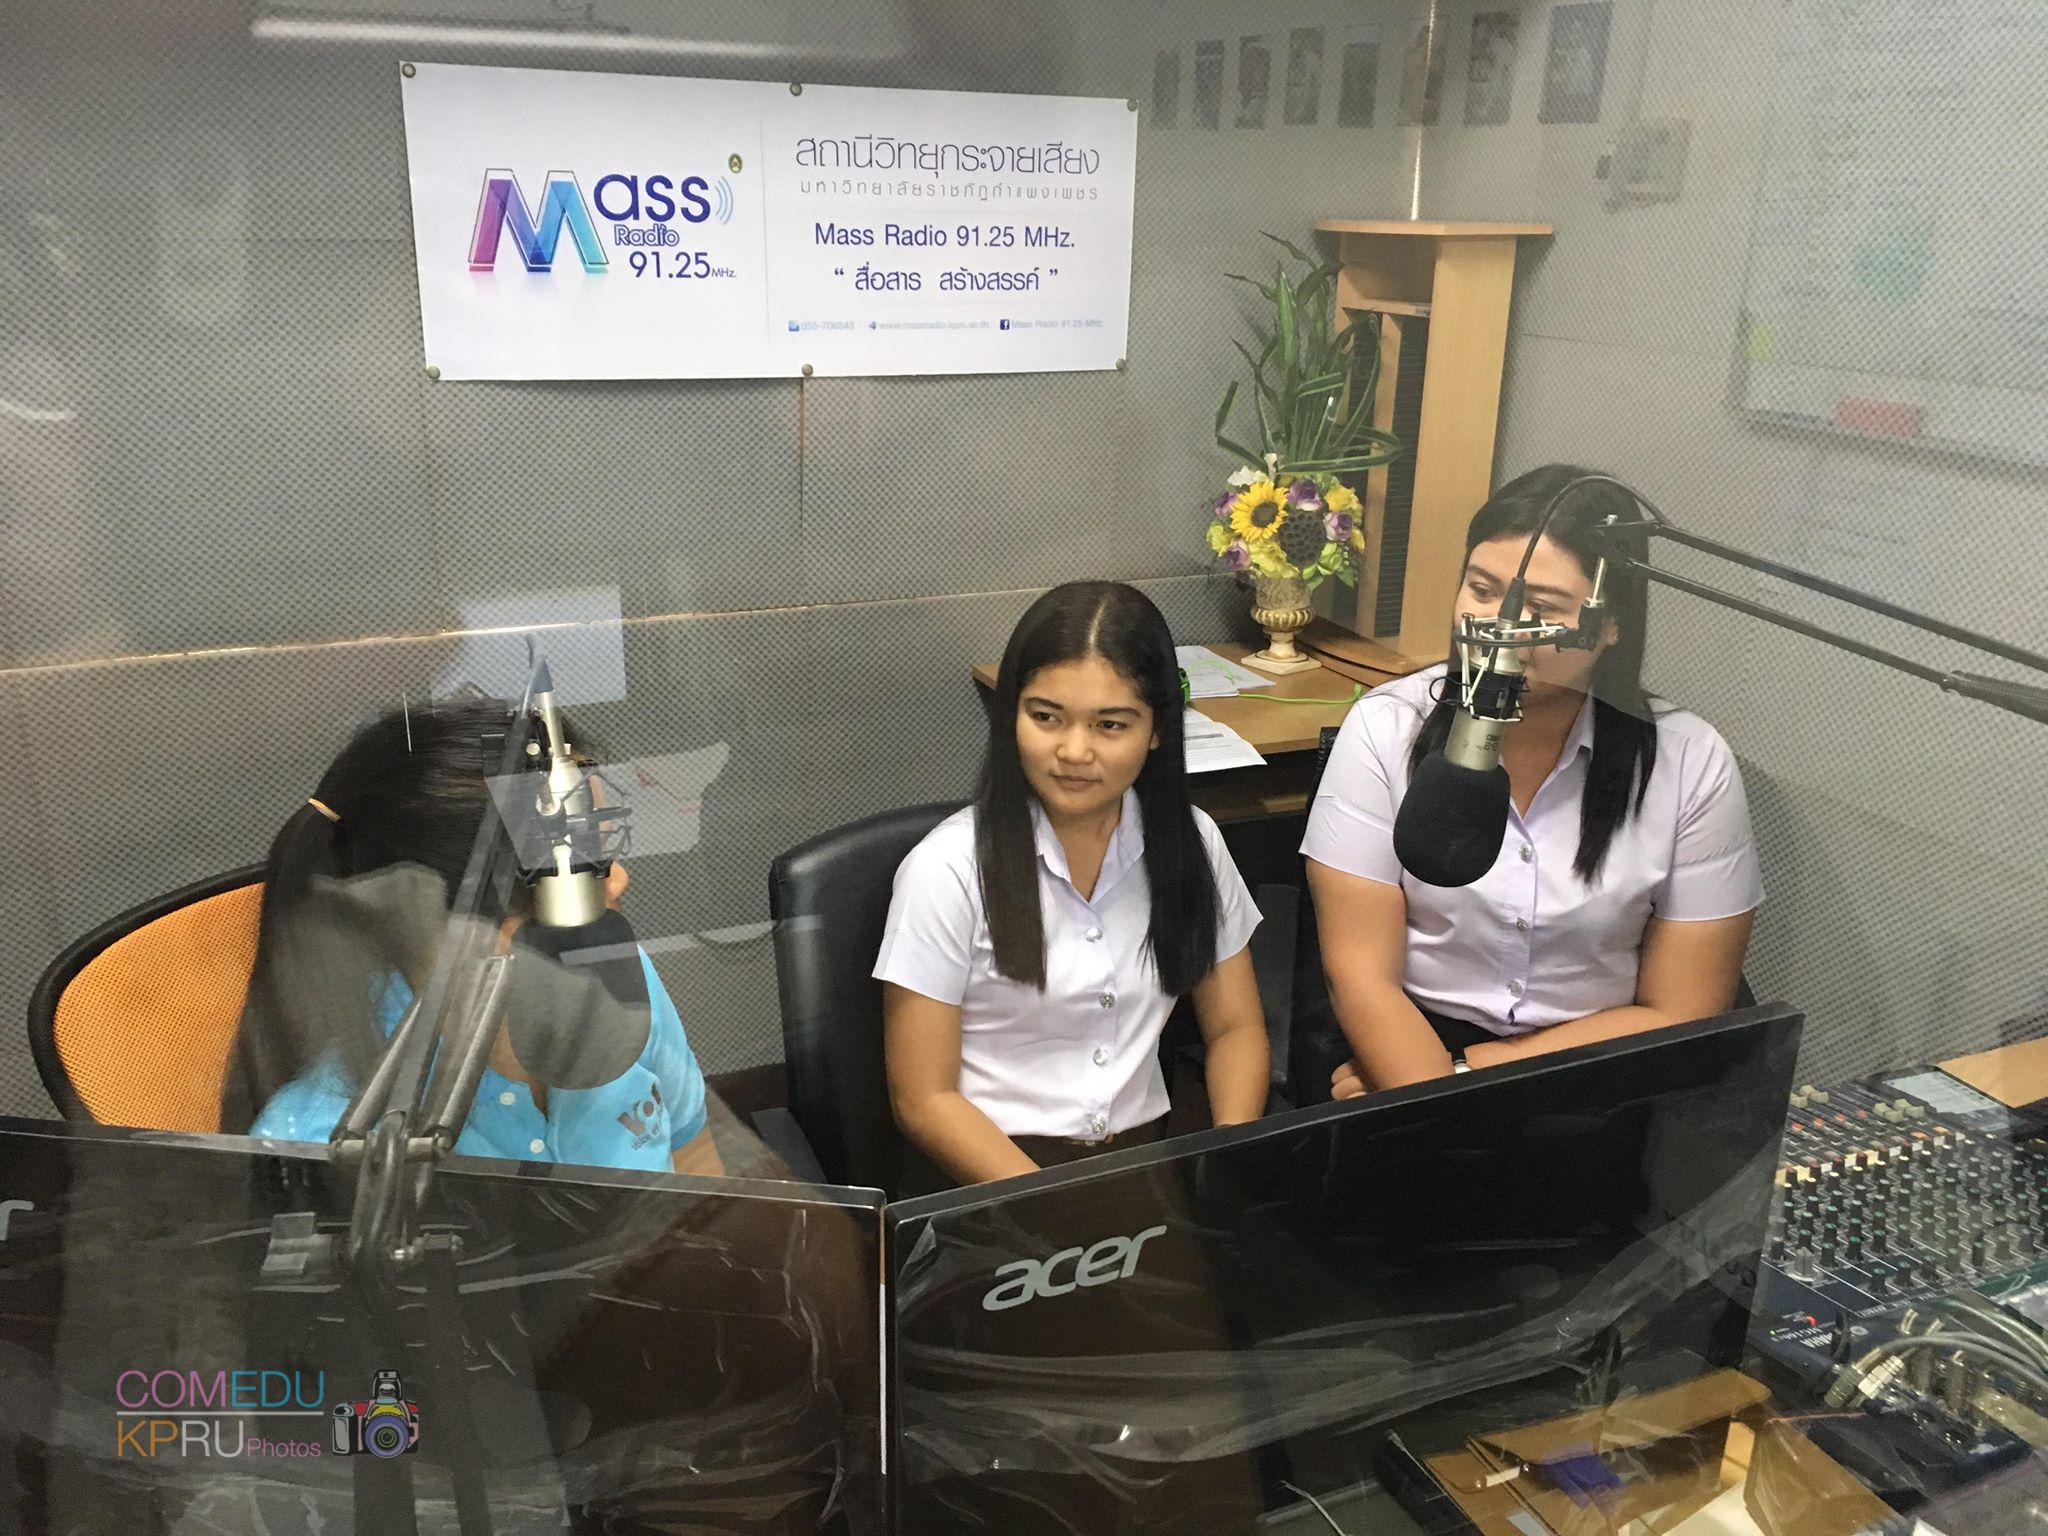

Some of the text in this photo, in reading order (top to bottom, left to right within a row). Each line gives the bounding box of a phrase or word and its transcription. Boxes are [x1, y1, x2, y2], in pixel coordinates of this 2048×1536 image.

[796, 134, 1100, 178] สถานีวิทยุกระจายเสียง
[467, 168, 711, 273] Mass
[614, 223, 680, 247] Radio
[815, 223, 1075, 247] Mass Radio 91.25 MHz.
[629, 251, 711, 278] 91.25
[855, 261, 922, 291] สื่อสาร
[939, 267, 1040, 291] สร้างสรรค์
[982, 1225, 1168, 1311] acer
